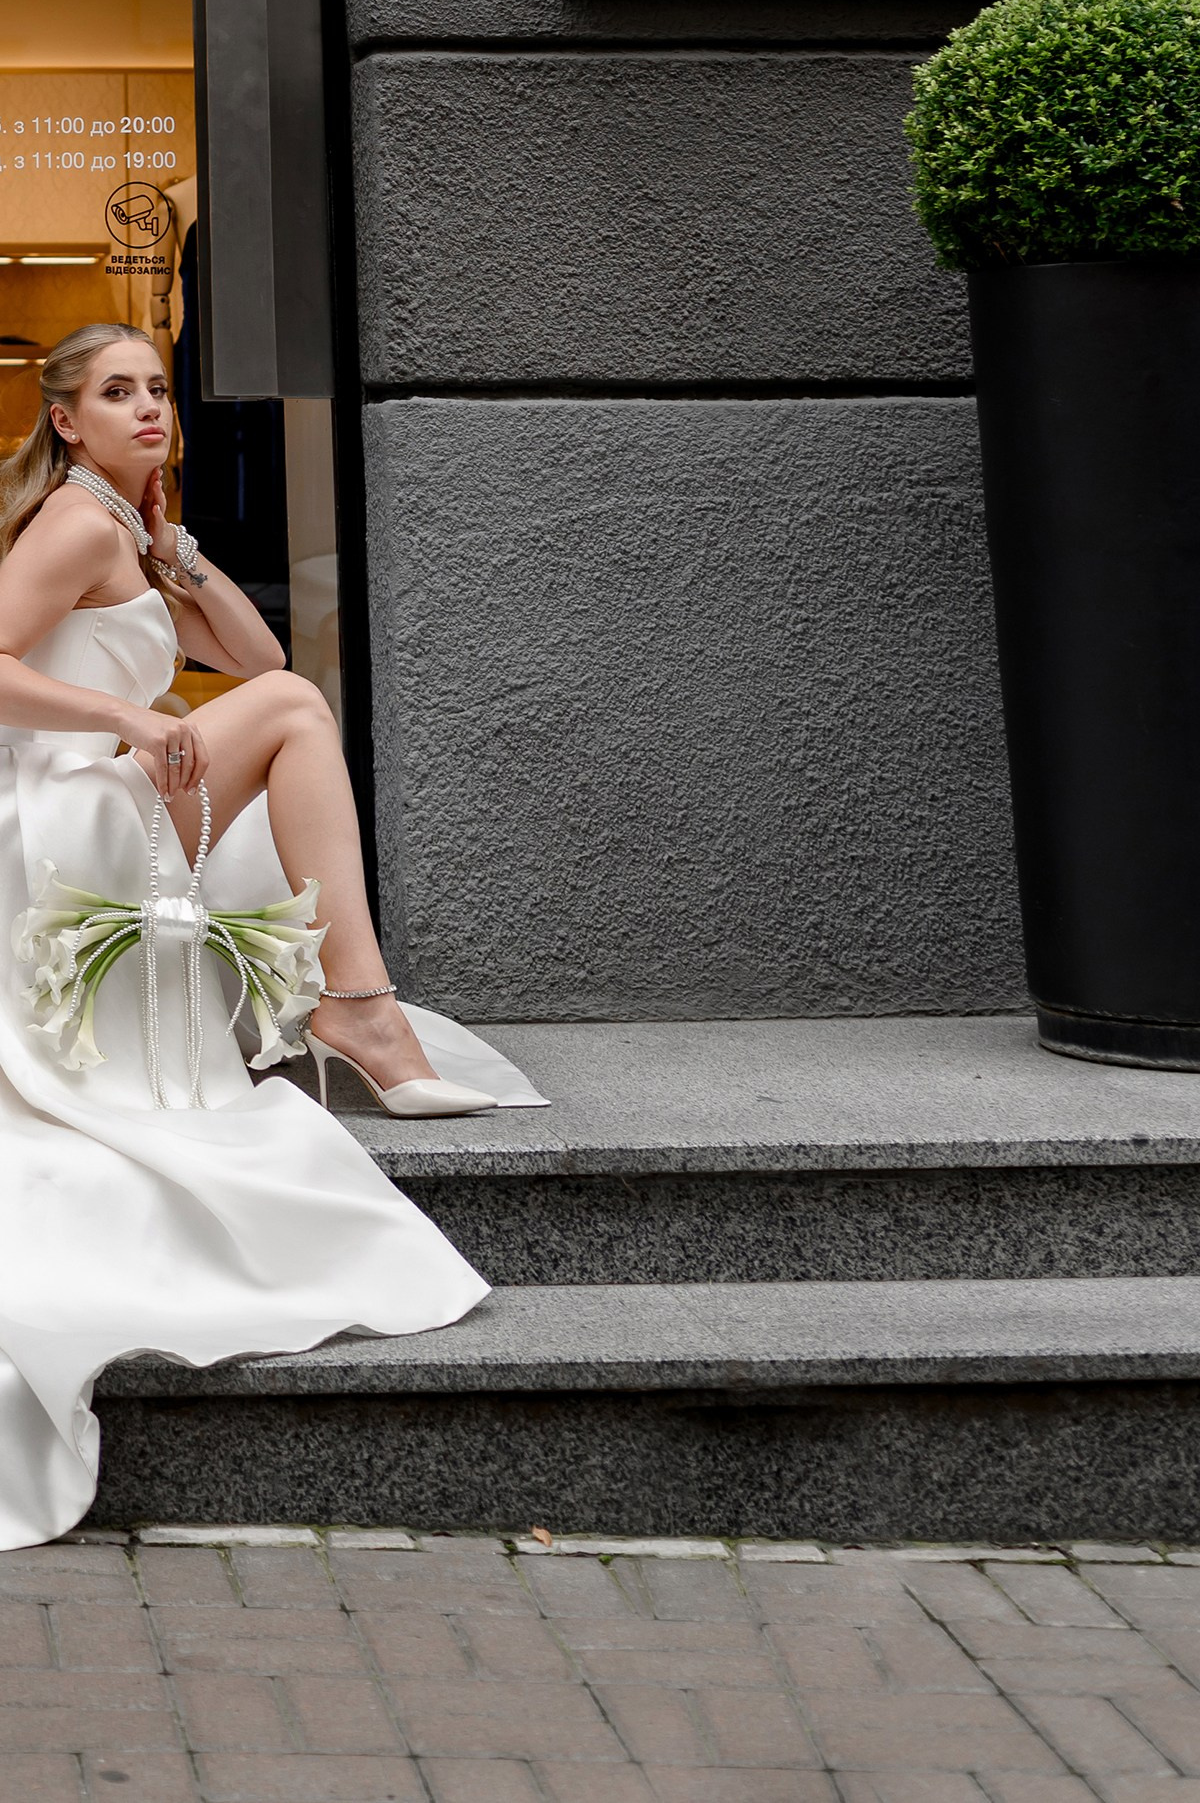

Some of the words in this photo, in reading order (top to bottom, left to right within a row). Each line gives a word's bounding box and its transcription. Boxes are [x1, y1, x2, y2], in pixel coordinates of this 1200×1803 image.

[32, 116, 85, 134] 11:00
[90, 121, 116, 137] до
[120, 116, 176, 134] 20:00
[32, 151, 85, 169] 11:00
[90, 155, 117, 172] до
[123, 151, 177, 169] 19:00
[111, 255, 166, 265] ВЕДЕТЬСЯ
[105, 266, 171, 276] ВІДЕОЗАПИС
